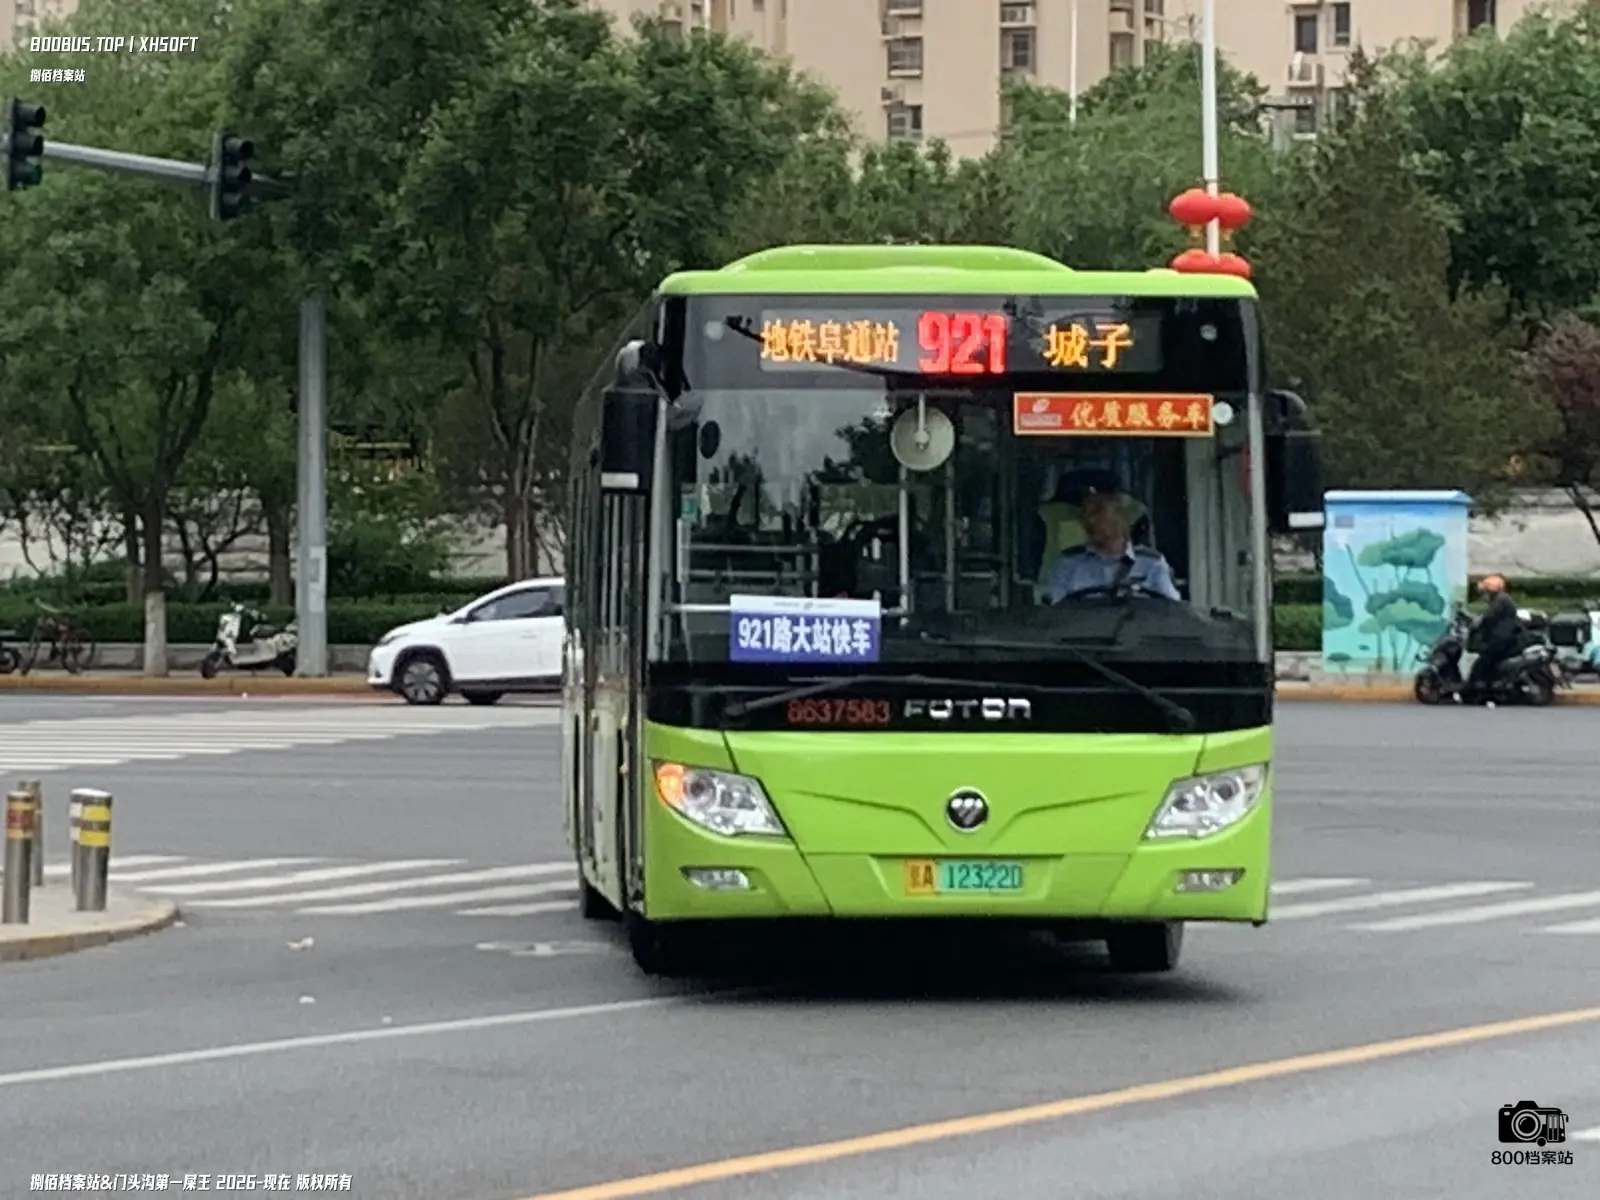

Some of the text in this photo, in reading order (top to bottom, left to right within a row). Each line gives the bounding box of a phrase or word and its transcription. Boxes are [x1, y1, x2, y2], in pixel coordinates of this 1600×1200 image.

[917, 311, 1007, 374] 921
[1043, 322, 1133, 369] 城子
[738, 616, 872, 656] 921路大站快车
[903, 697, 1032, 720] FOTON
